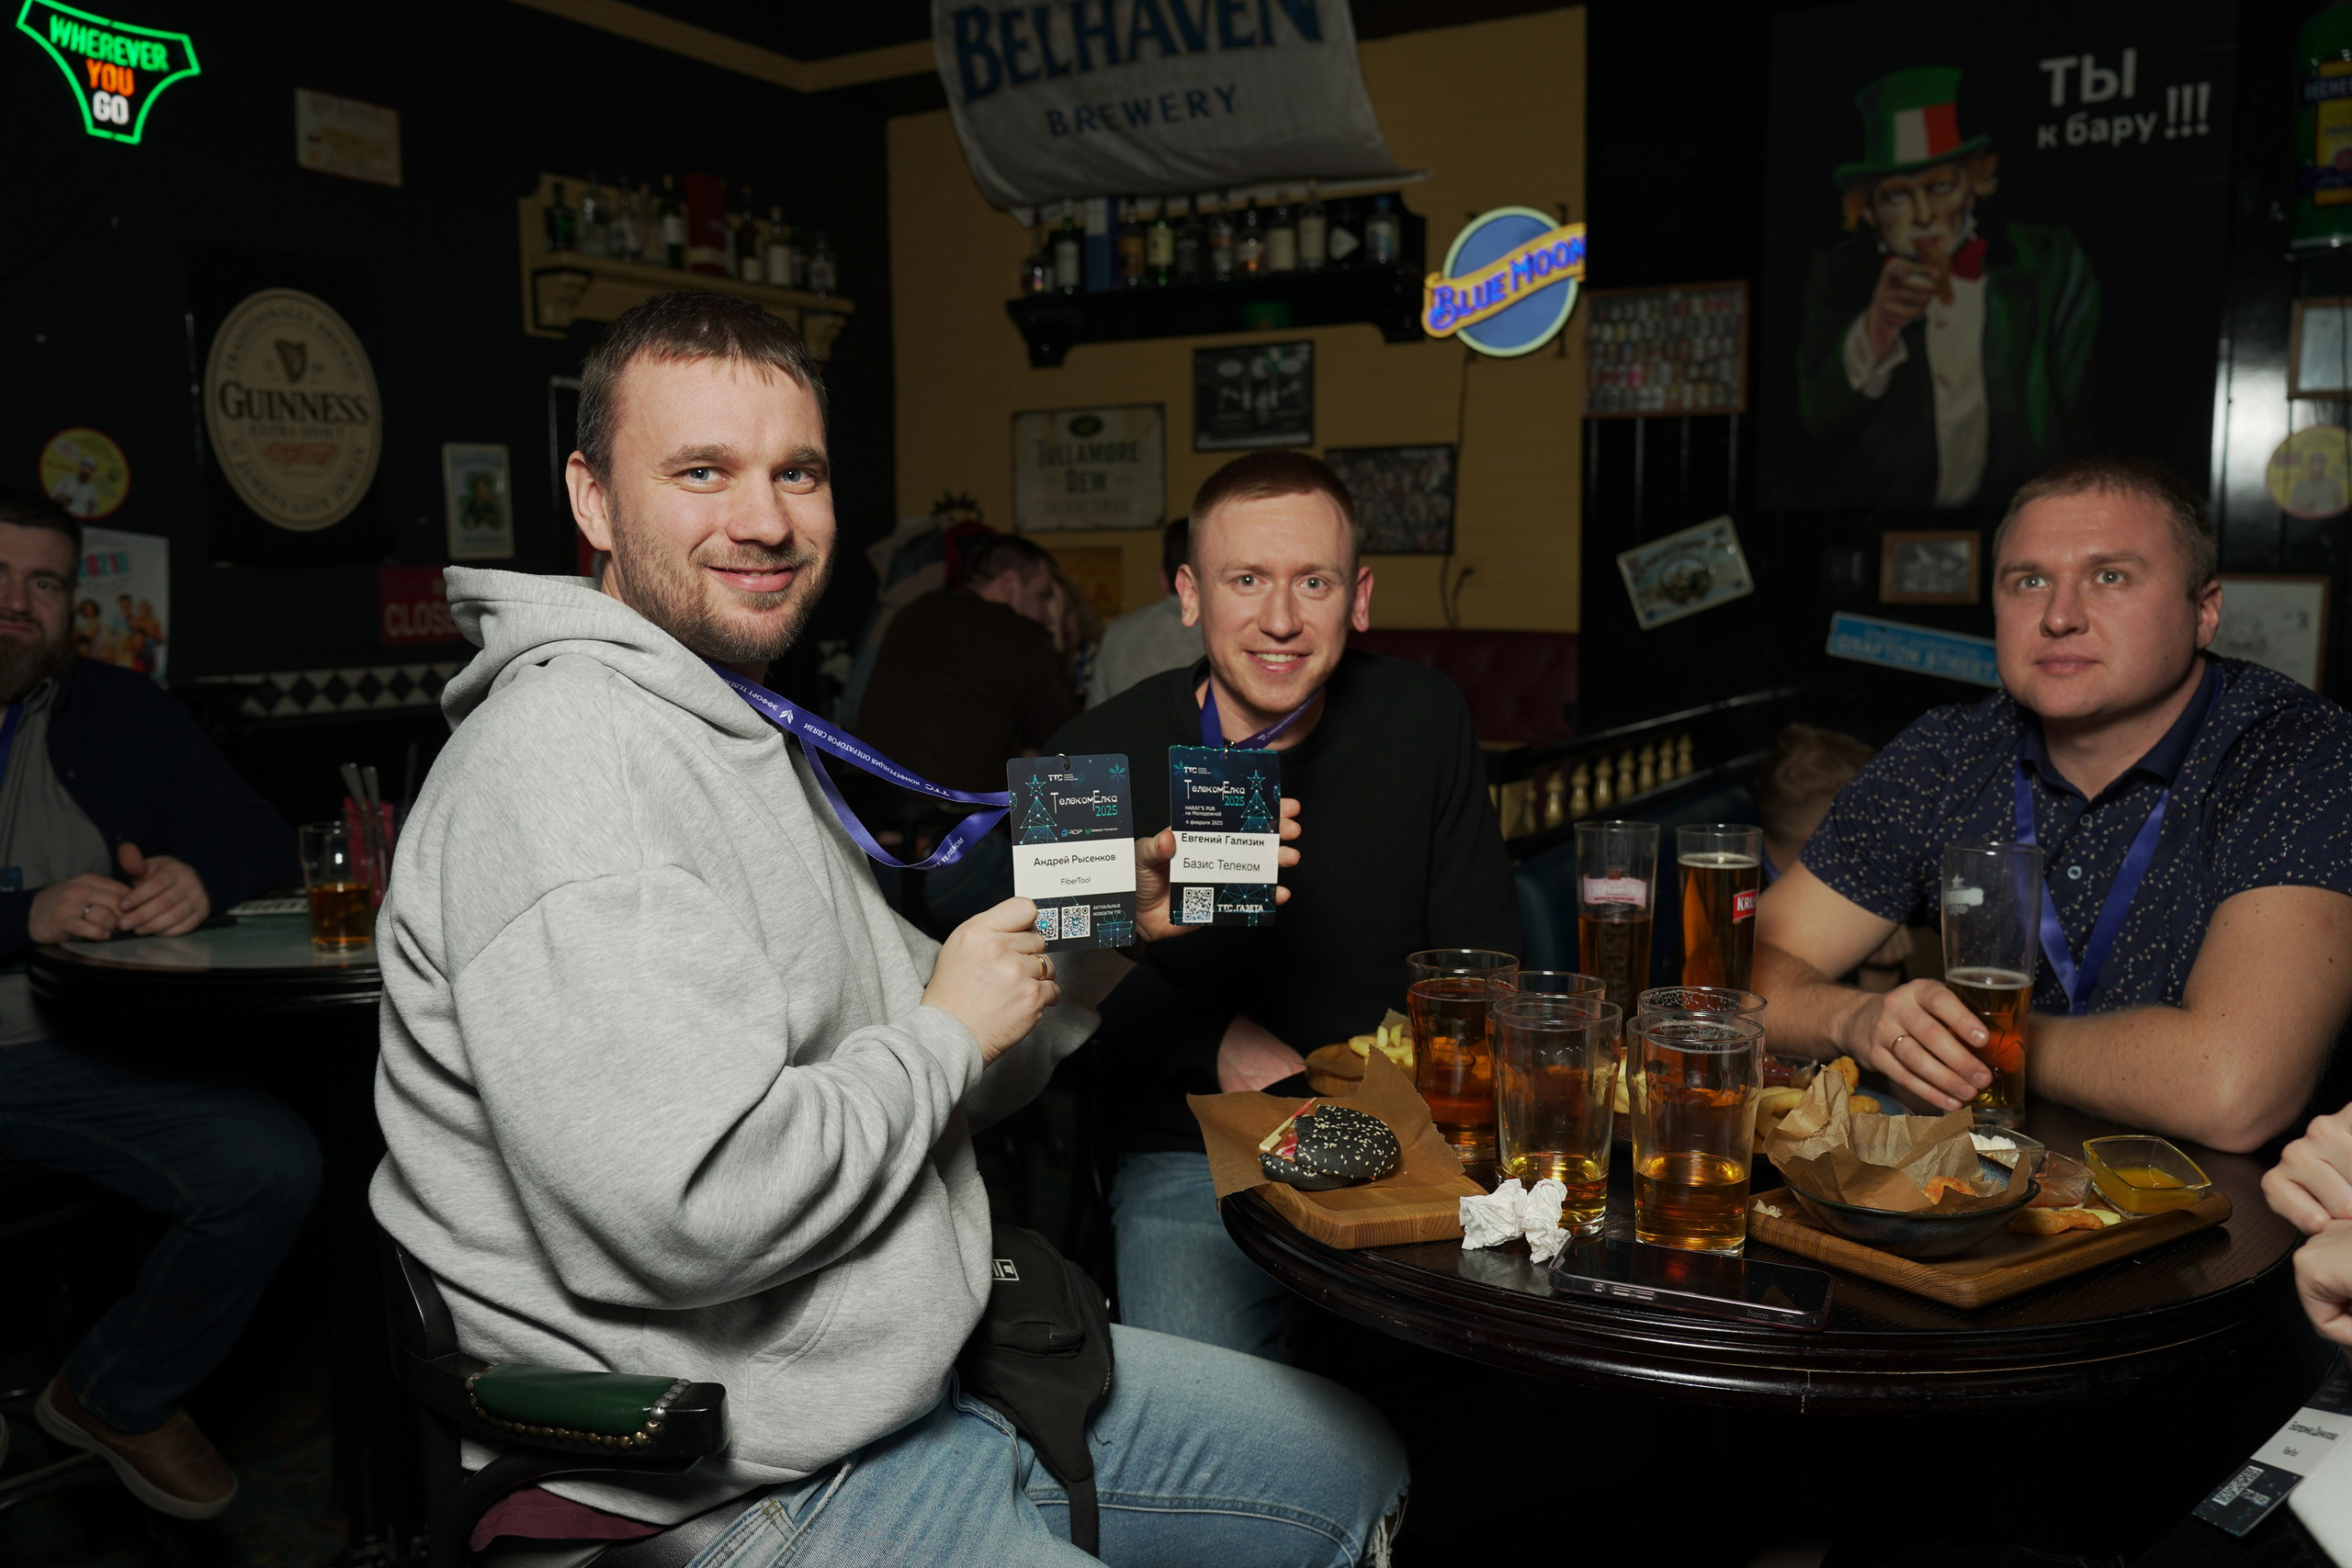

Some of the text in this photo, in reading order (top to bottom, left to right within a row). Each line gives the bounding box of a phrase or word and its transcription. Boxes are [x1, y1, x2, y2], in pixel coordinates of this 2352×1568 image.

[50, 14, 169, 72] WHEREVER
[952, 0, 1323, 103] BELHAVEN
[85, 58, 134, 96] YOU
[2038, 47, 2137, 108] ТЫ
[93, 90, 130, 125] GO
[1046, 85, 1237, 137] BREWERY
[2036, 123, 2059, 150] к
[2064, 110, 2159, 148] бару
[1428, 233, 1587, 331] BLUE MOON
[219, 378, 369, 427] GUINNESS
[1036, 438, 1139, 470] TULLAMORE
[1066, 469, 1108, 493] DEW
[749, 689, 778, 711] ЭФФОРТ
[803, 722, 950, 796] ТТС КОНФЕРЕНЦИЯ ОПЕРАТОРОВ СВЯЗИ
[1094, 805, 1118, 817] 2025
[1224, 795, 1245, 807] 2025
[941, 837, 965, 863] ТЕЛЕКОМ
[1181, 832, 1265, 846] Евгений Гализин
[1034, 854, 1116, 867] Андрей Рысенков
[1182, 857, 1261, 872] Базис Телеком
[1060, 875, 1091, 886] FiberTool
